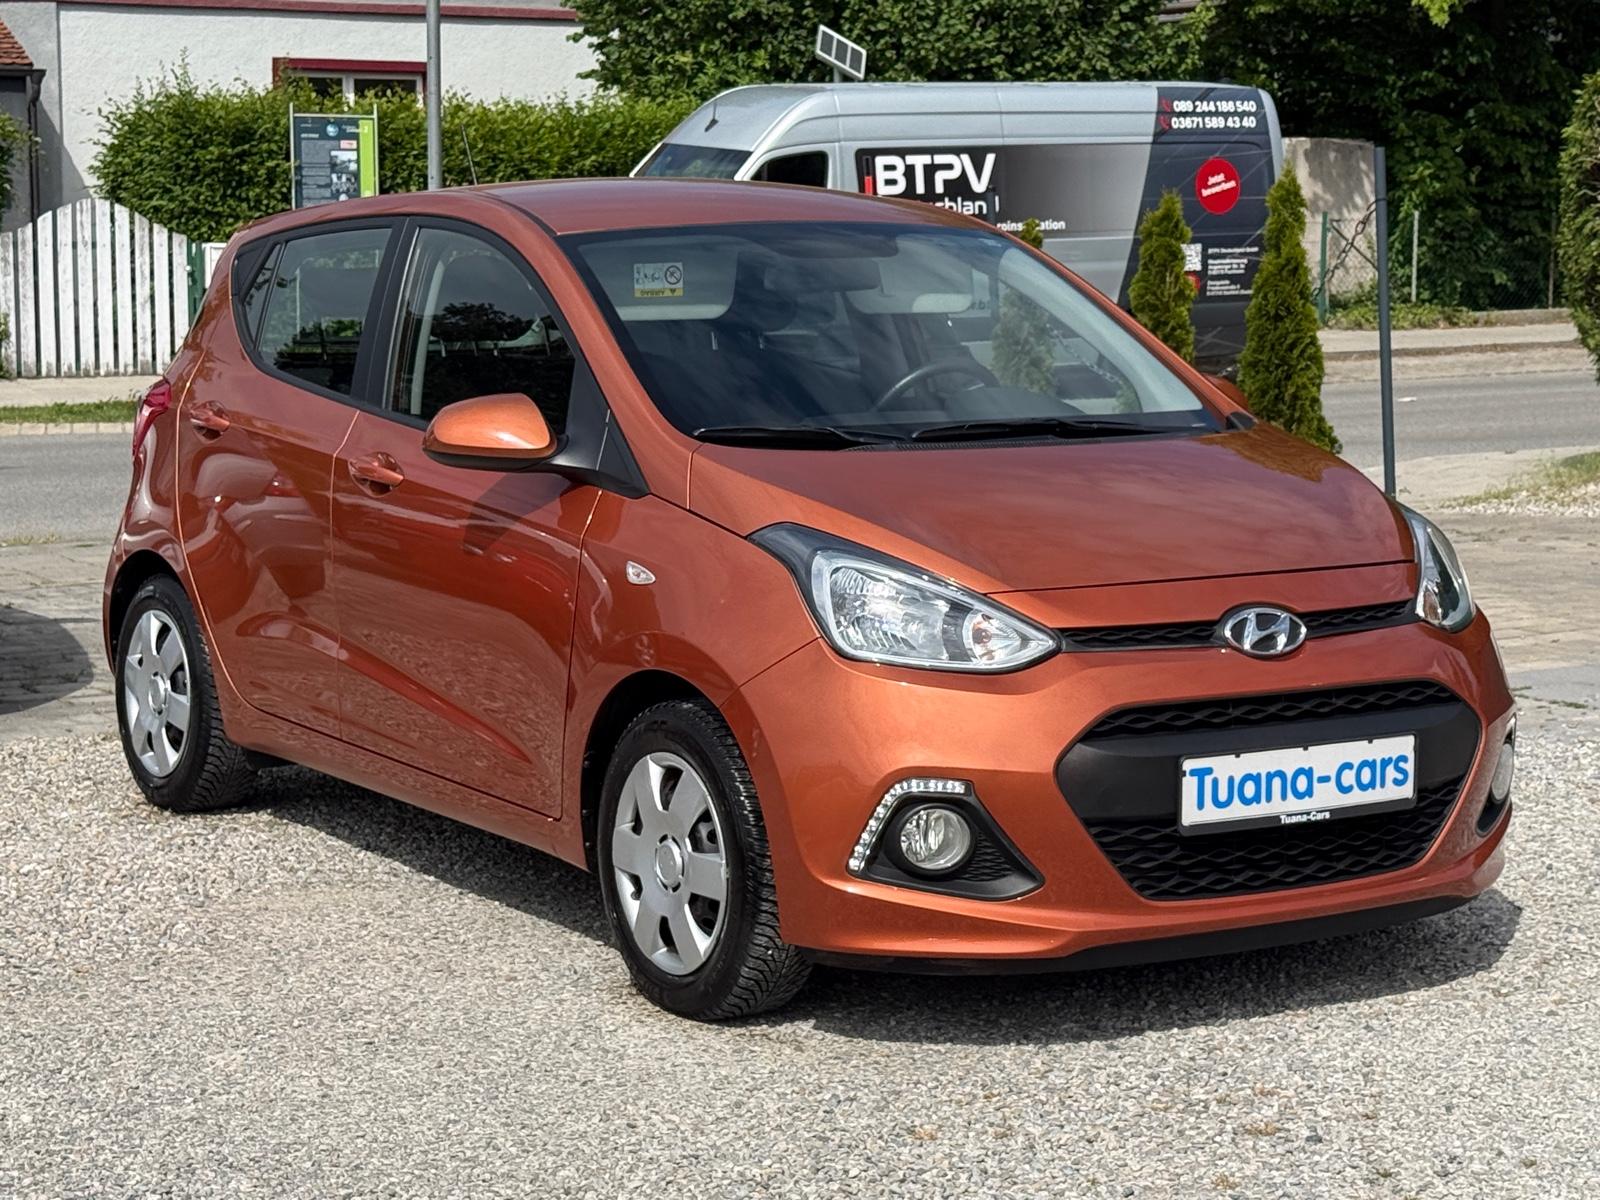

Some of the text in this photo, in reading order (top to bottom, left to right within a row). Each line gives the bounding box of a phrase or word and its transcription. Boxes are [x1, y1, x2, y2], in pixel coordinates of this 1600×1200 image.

[1173, 100, 1194, 112] 089
[1195, 100, 1216, 112] 244
[1236, 100, 1257, 112] 540
[1205, 116, 1226, 129] 589
[1227, 116, 1240, 128] 43
[1242, 116, 1257, 128] 40
[874, 153, 997, 196] BTPV
[1188, 754, 1410, 811] Tuana-cars
[1279, 811, 1331, 825] Tuana-Cars
